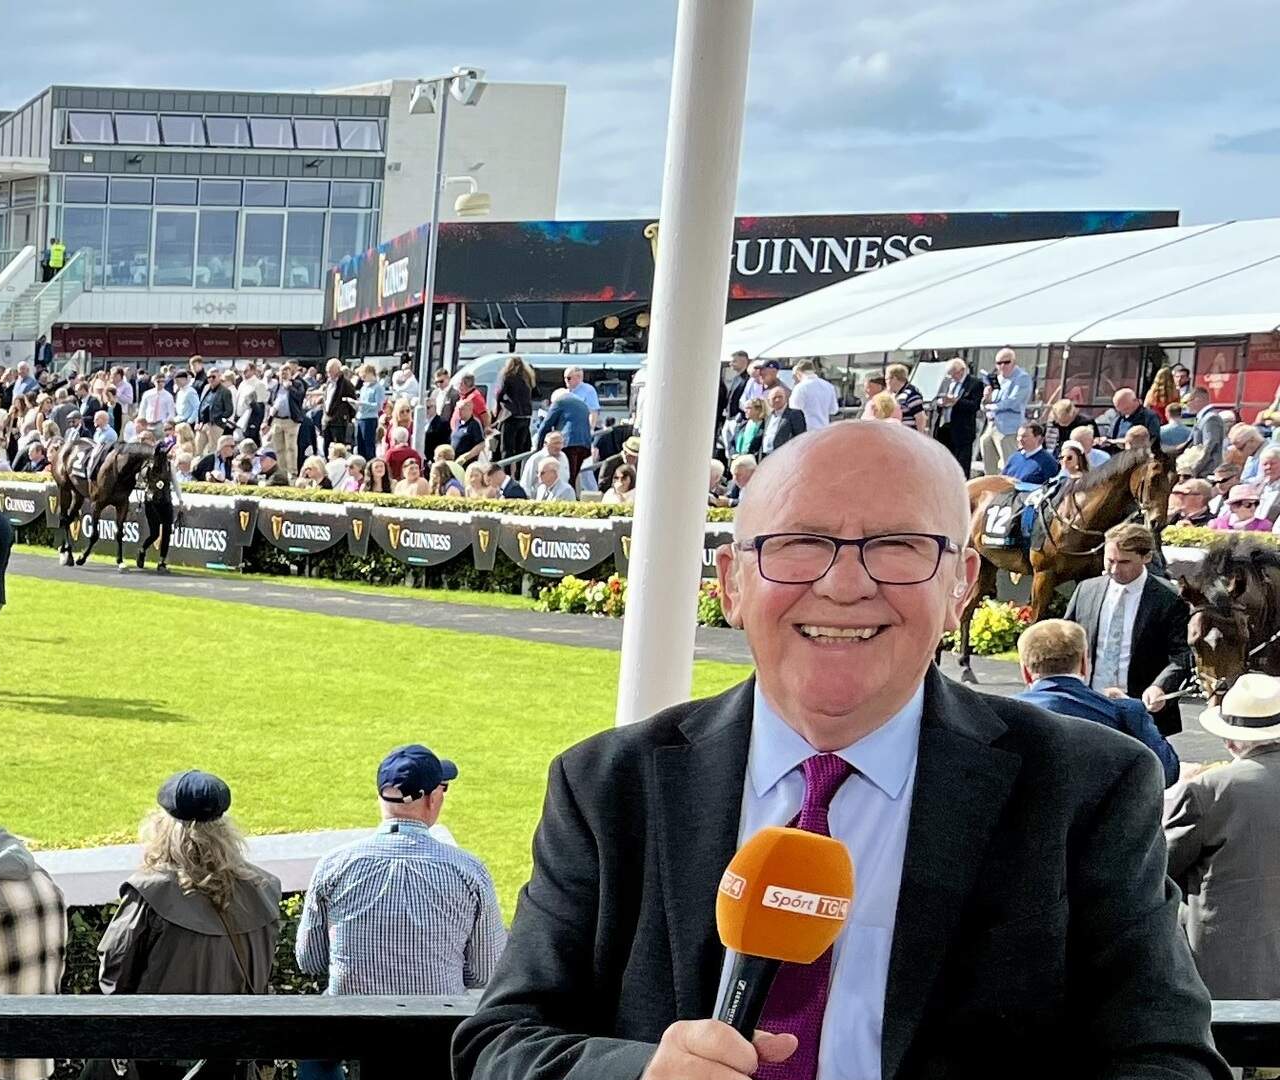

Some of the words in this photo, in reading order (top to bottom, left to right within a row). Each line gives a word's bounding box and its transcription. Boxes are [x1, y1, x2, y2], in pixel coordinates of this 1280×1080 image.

[730, 235, 933, 276] UINNESS
[156, 337, 190, 348] tote
[242, 337, 276, 348] tote
[4, 496, 35, 513] GUINNESS
[986, 505, 1012, 534] 12
[281, 522, 331, 542] GUINNESS
[400, 529, 451, 551] GUINNESS
[530, 538, 590, 560] GUINNESS
[769, 891, 813, 910] Spórt
